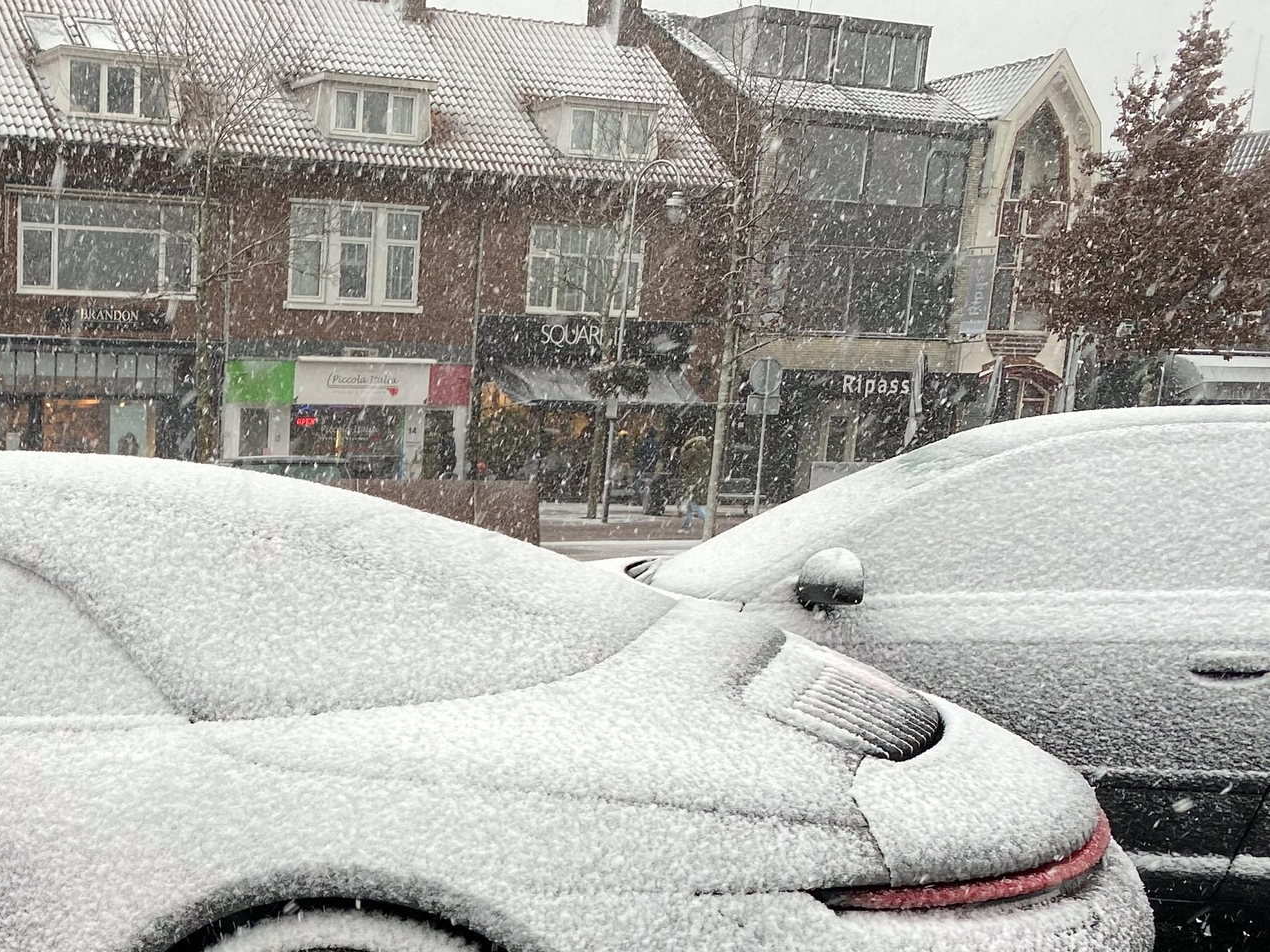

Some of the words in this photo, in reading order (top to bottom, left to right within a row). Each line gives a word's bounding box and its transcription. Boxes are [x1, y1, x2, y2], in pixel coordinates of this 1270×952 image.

[80, 308, 139, 322] BRANDON
[541, 324, 604, 348] SQUAR
[332, 373, 368, 385] Piccola
[370, 374, 399, 385] Italia
[842, 374, 911, 398] Ripass
[296, 417, 316, 426] OPEN
[408, 427, 417, 435] 14
